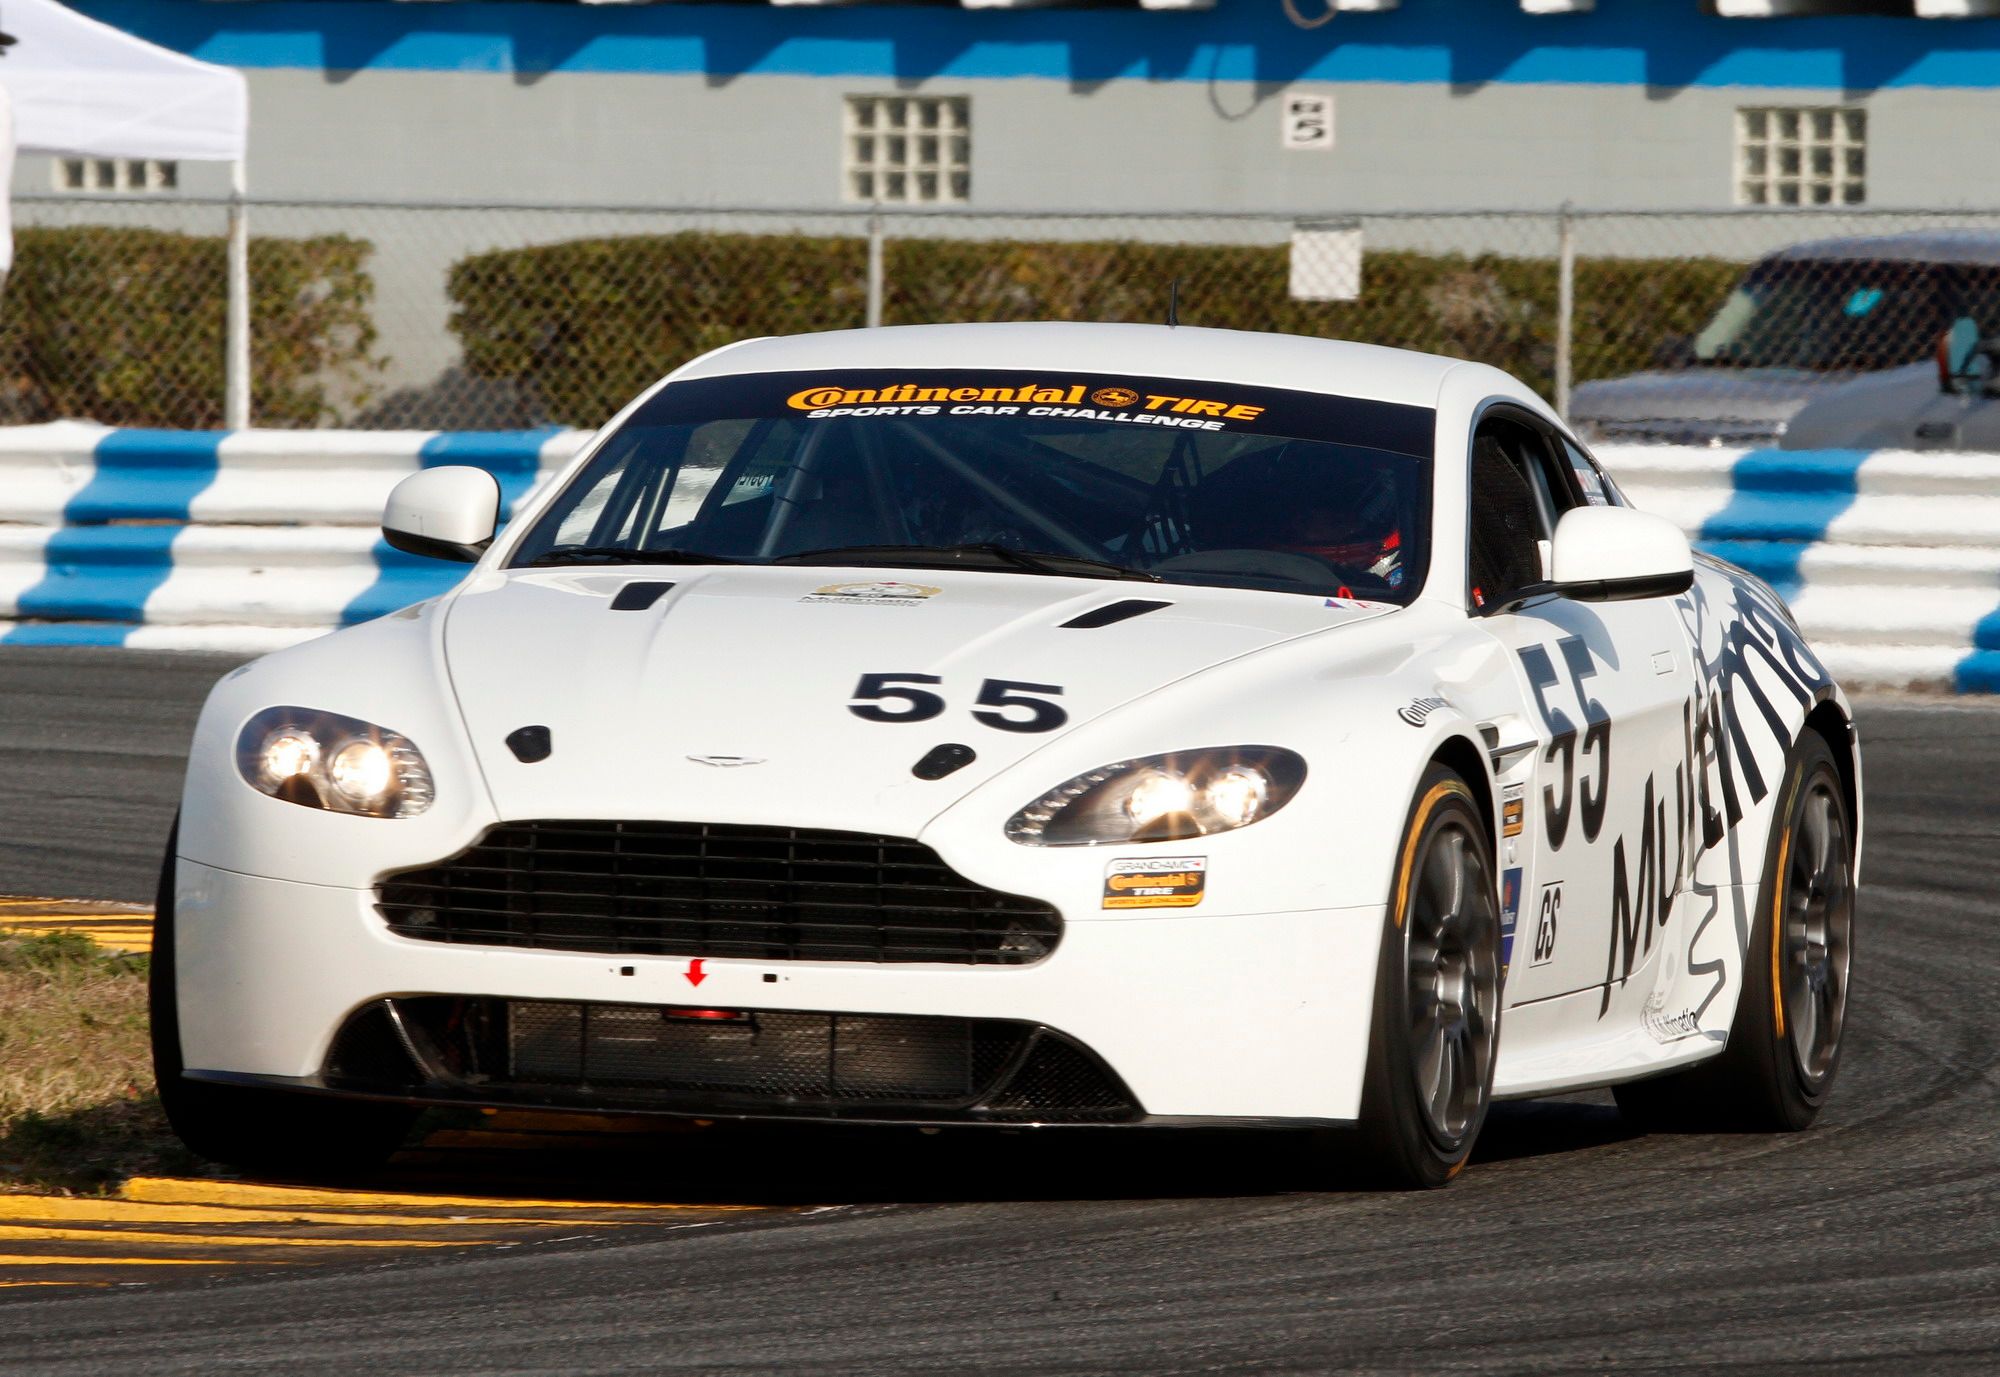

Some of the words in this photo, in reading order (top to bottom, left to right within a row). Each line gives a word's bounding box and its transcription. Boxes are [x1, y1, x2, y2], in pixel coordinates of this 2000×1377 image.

[787, 384, 1087, 410] Continental
[1145, 395, 1265, 421] TIRE
[807, 406, 941, 419] SPORTS
[950, 406, 1020, 415] CAR
[1027, 407, 1226, 431] CHALLENGE
[1517, 634, 1612, 852] 55
[1132, 887, 1175, 896] TIRE
[1534, 886, 1561, 961] GS
